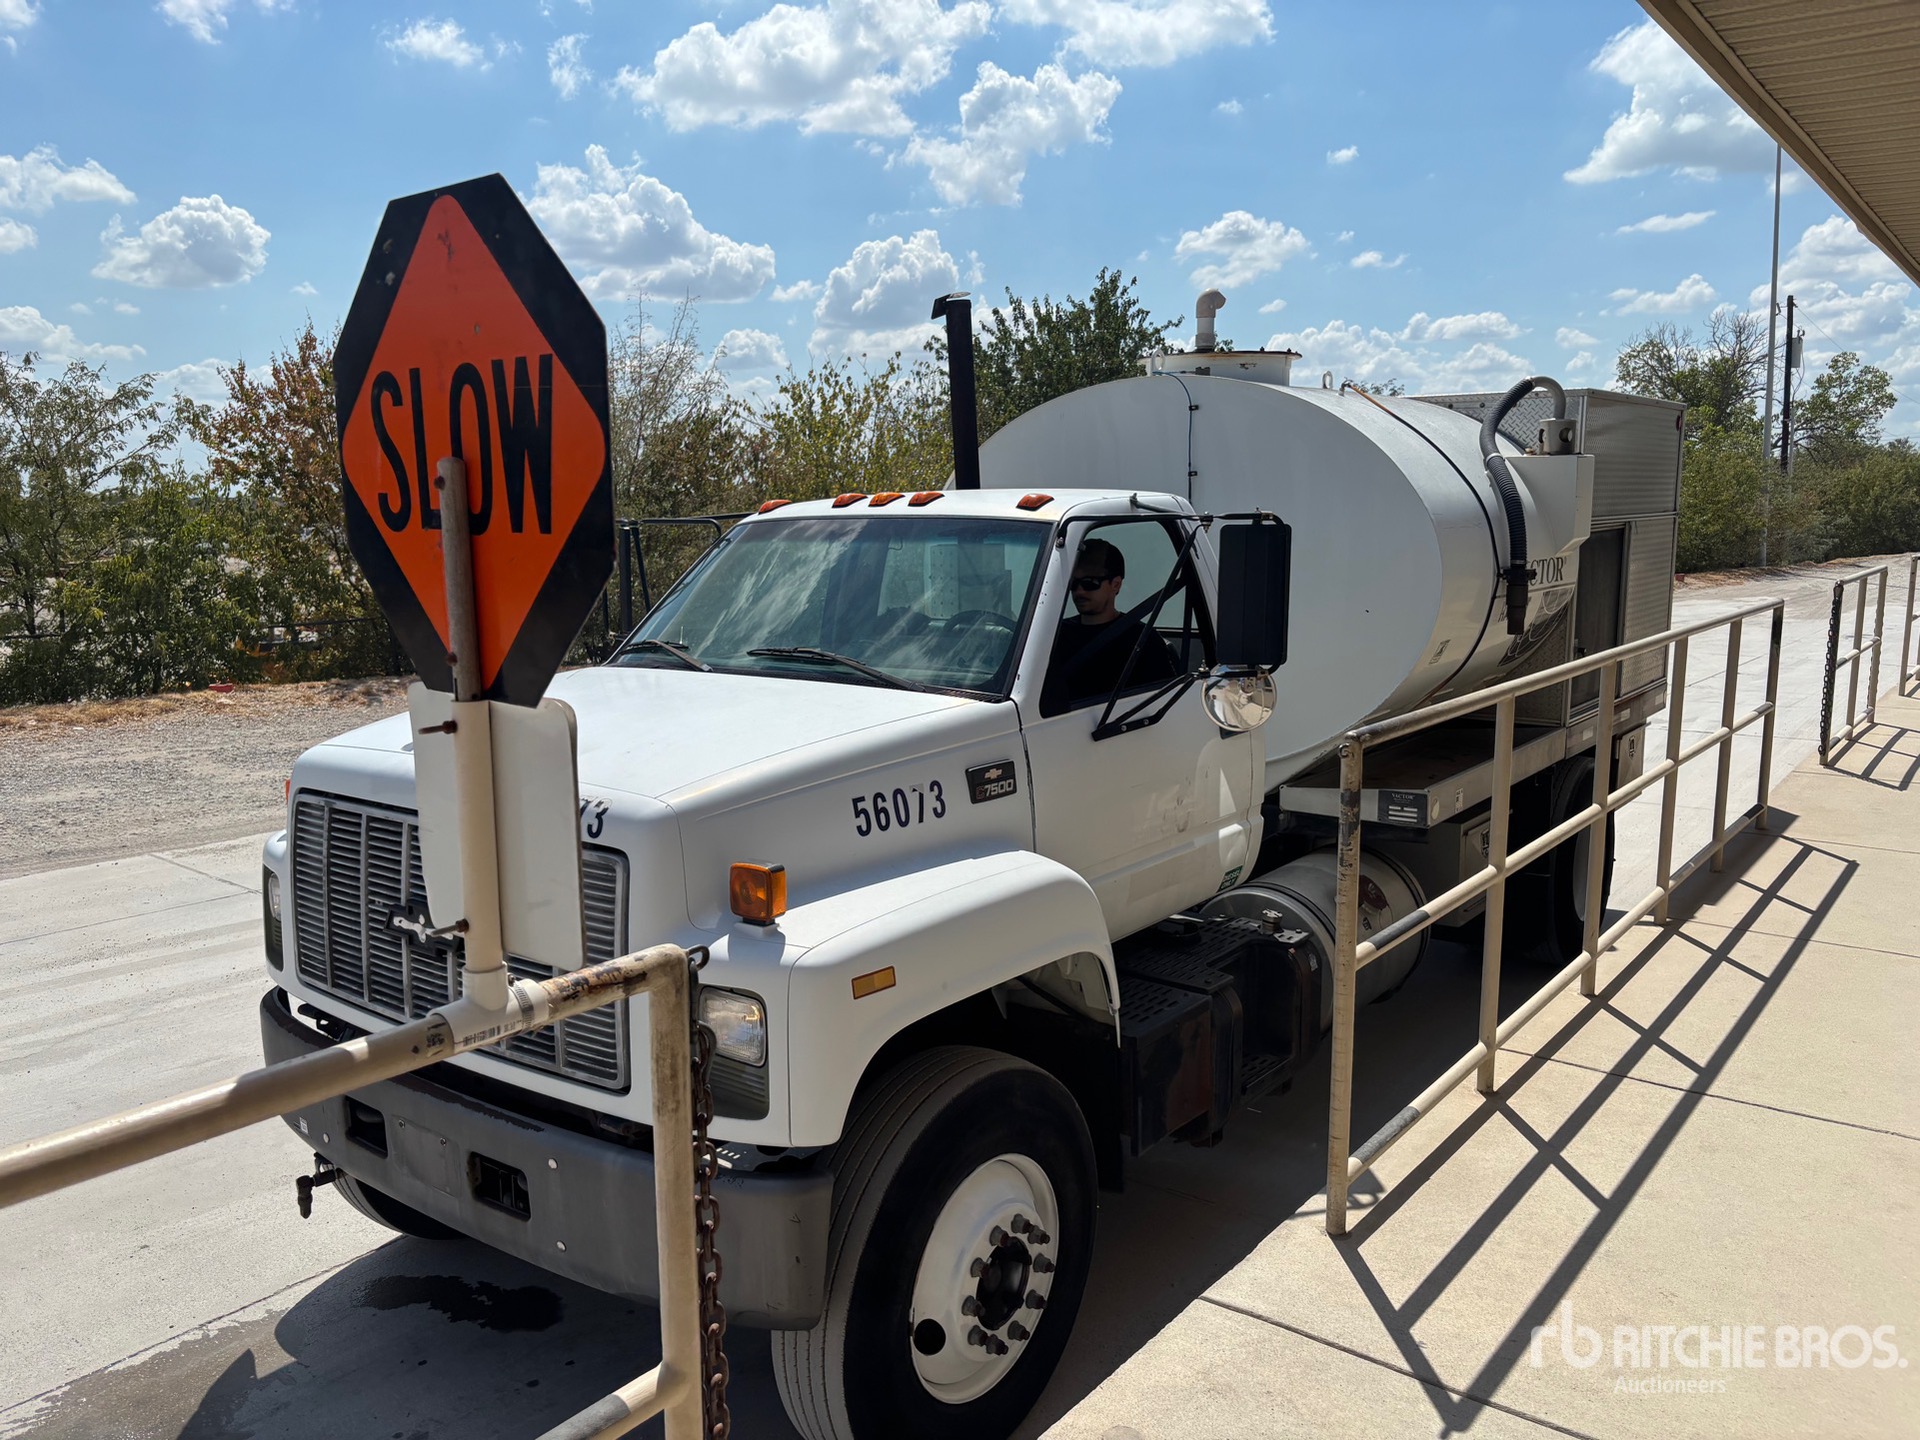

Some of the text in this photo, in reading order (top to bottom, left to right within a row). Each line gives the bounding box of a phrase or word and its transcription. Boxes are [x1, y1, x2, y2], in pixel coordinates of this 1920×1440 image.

[371, 353, 554, 536] SLOW
[852, 780, 946, 837] 56073
[976, 779, 1014, 800] C7500
